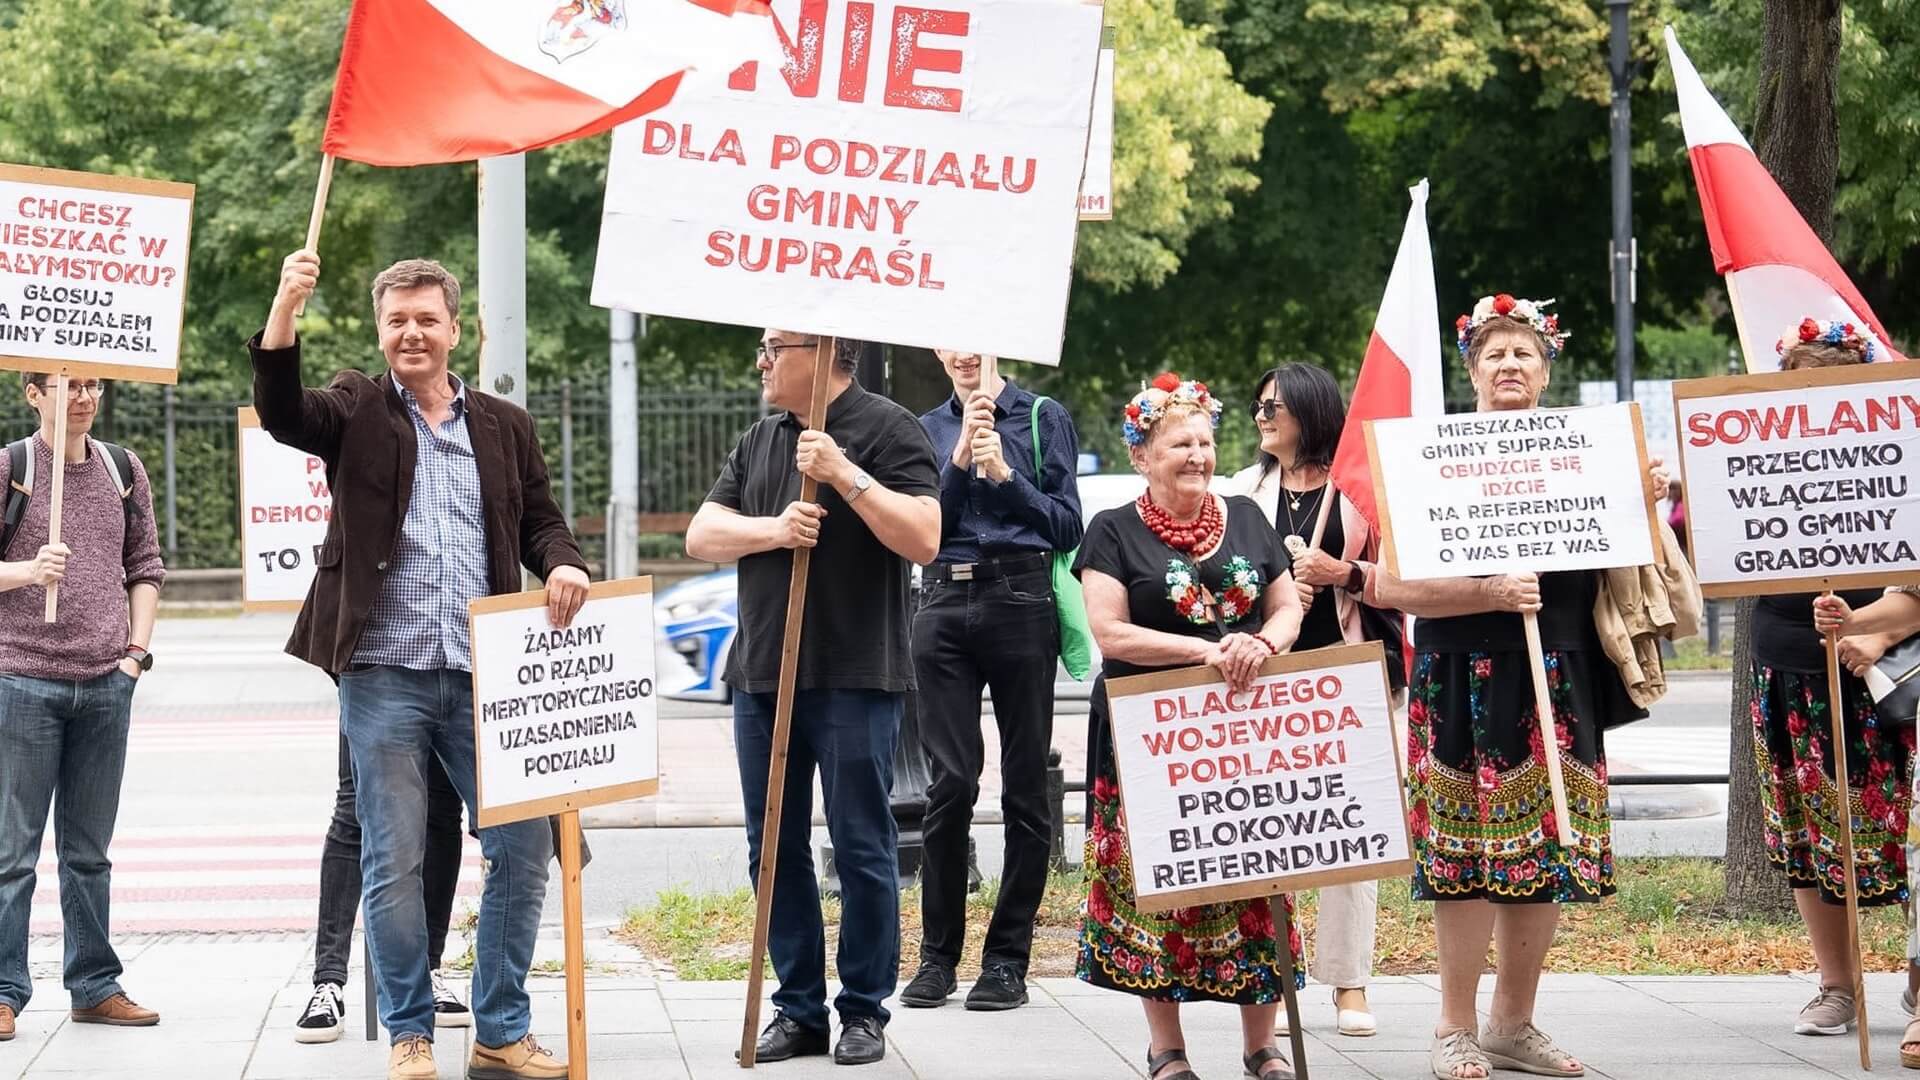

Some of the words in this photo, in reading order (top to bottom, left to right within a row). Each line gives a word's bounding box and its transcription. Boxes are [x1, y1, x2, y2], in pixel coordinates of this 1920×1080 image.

[728, 0, 970, 112] NIE
[642, 119, 747, 166] DLA
[770, 134, 1037, 194] PODZIAŁU
[18, 196, 133, 227] CHCESZ
[747, 183, 920, 235] GMINY
[0, 222, 127, 255] IESZKAĆ
[139, 236, 168, 258] W
[704, 230, 945, 290] SUPRAŚL
[23, 284, 114, 307] GŁOSUJ
[20, 305, 152, 331] PODZIAŁEM
[0, 324, 46, 343] INY
[54, 328, 157, 353] SUPRAŚL
[1437, 413, 1569, 439] MIESZKAŃCY
[1688, 395, 1920, 447] SOWLANY
[1422, 440, 1488, 460] GMINY
[1497, 431, 1593, 455] SUPRAŚL
[1727, 443, 1903, 478] PRZECIWKO
[1439, 456, 1543, 480] OBUDŹCIE
[1550, 455, 1583, 474] SIĘ
[1482, 476, 1547, 497] IDŹCIE
[1728, 475, 1907, 511] WŁĄCZENIU
[1428, 505, 1460, 522] NA
[1468, 495, 1607, 520] REFERENDUM
[1745, 516, 1788, 541] DO
[1798, 509, 1897, 537] GMINY
[1441, 526, 1470, 542] BO
[1477, 516, 1603, 539] ZDECYDUJĄ
[259, 548, 301, 572] TO
[1439, 547, 1455, 563] O
[1463, 544, 1509, 561] WAS
[1517, 541, 1556, 558] BEZ
[1563, 537, 1611, 555] WAS
[1734, 538, 1918, 573] GRABÓWKA
[525, 624, 606, 656] ŻĄDAMY
[517, 664, 544, 685] OD
[482, 678, 653, 723] MERYTORYCZNEGO
[1153, 674, 1342, 723] DLACZEGO
[500, 711, 637, 750] UZASADNIENIA
[1142, 705, 1363, 757] WOJEWODA
[524, 743, 616, 777] PODZIAŁU
[1167, 739, 1347, 787] PODLASKI
[1178, 773, 1346, 818] PRÓBUJE
[1169, 796, 1365, 853] BLOKOWAĆ
[1152, 832, 1389, 889] REFERNDUM?
